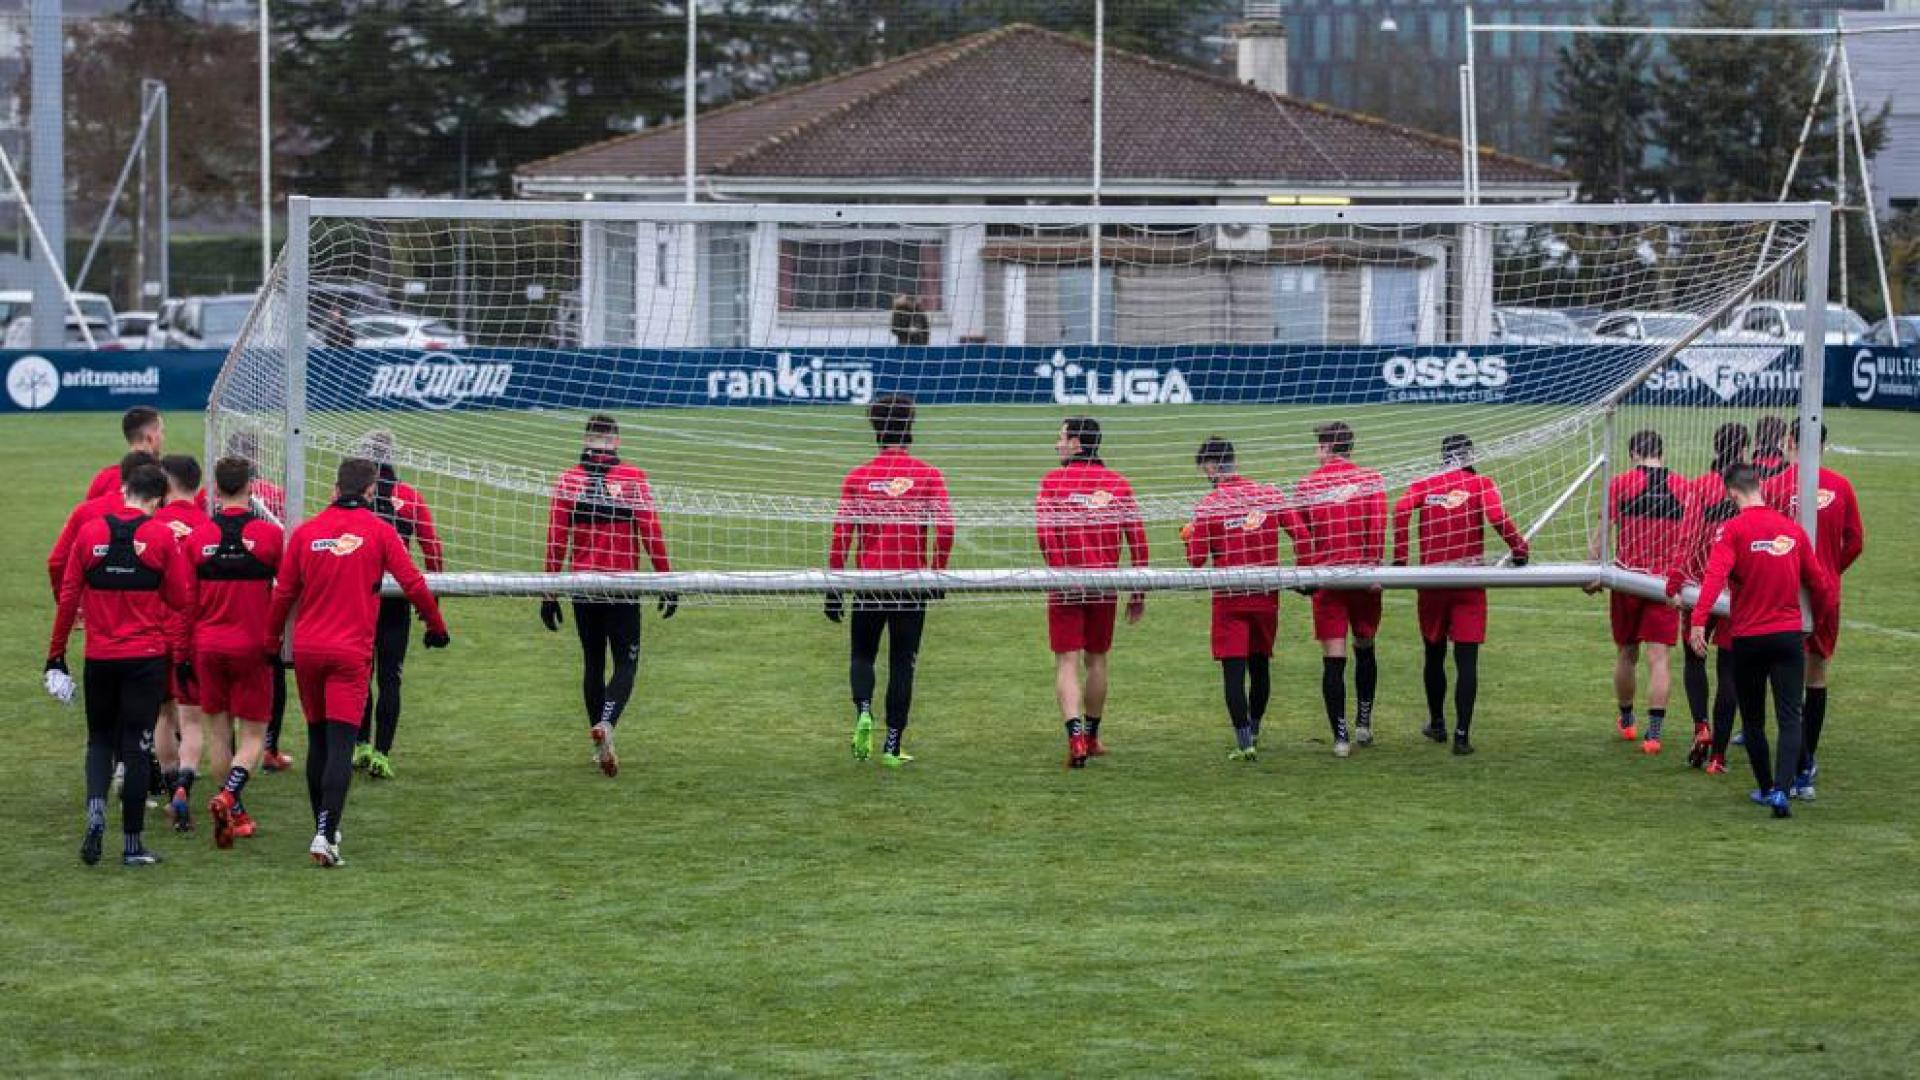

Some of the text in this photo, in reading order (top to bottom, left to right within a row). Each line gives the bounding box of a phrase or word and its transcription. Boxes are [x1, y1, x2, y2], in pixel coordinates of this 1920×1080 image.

[62, 366, 159, 387] aritzmendi
[707, 352, 874, 404] ranking
[1052, 366, 1194, 404] LUGA
